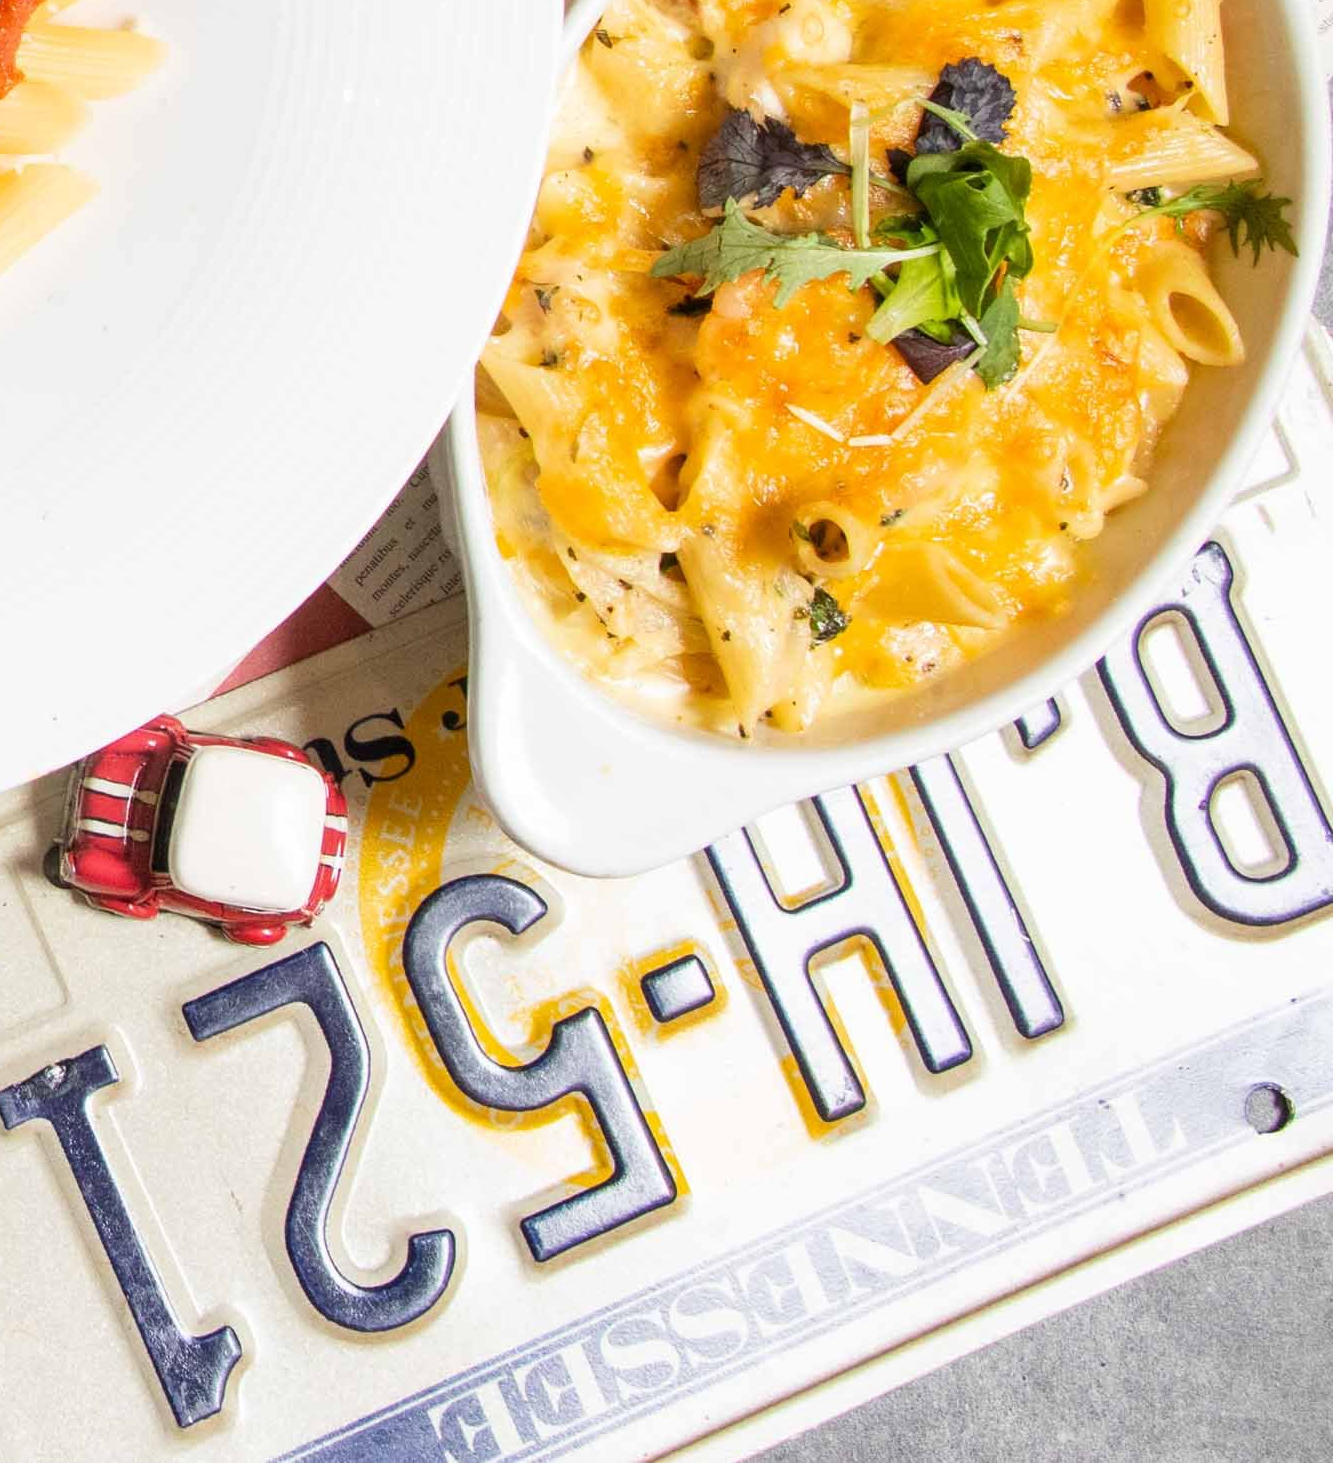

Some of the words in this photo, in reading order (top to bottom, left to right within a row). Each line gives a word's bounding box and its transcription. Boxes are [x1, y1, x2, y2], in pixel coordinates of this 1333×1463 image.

[352, 536, 402, 588] penatibus
[386, 562, 440, 620] scelerisque
[435, 1093, 1189, 1463] TENNESSEE
